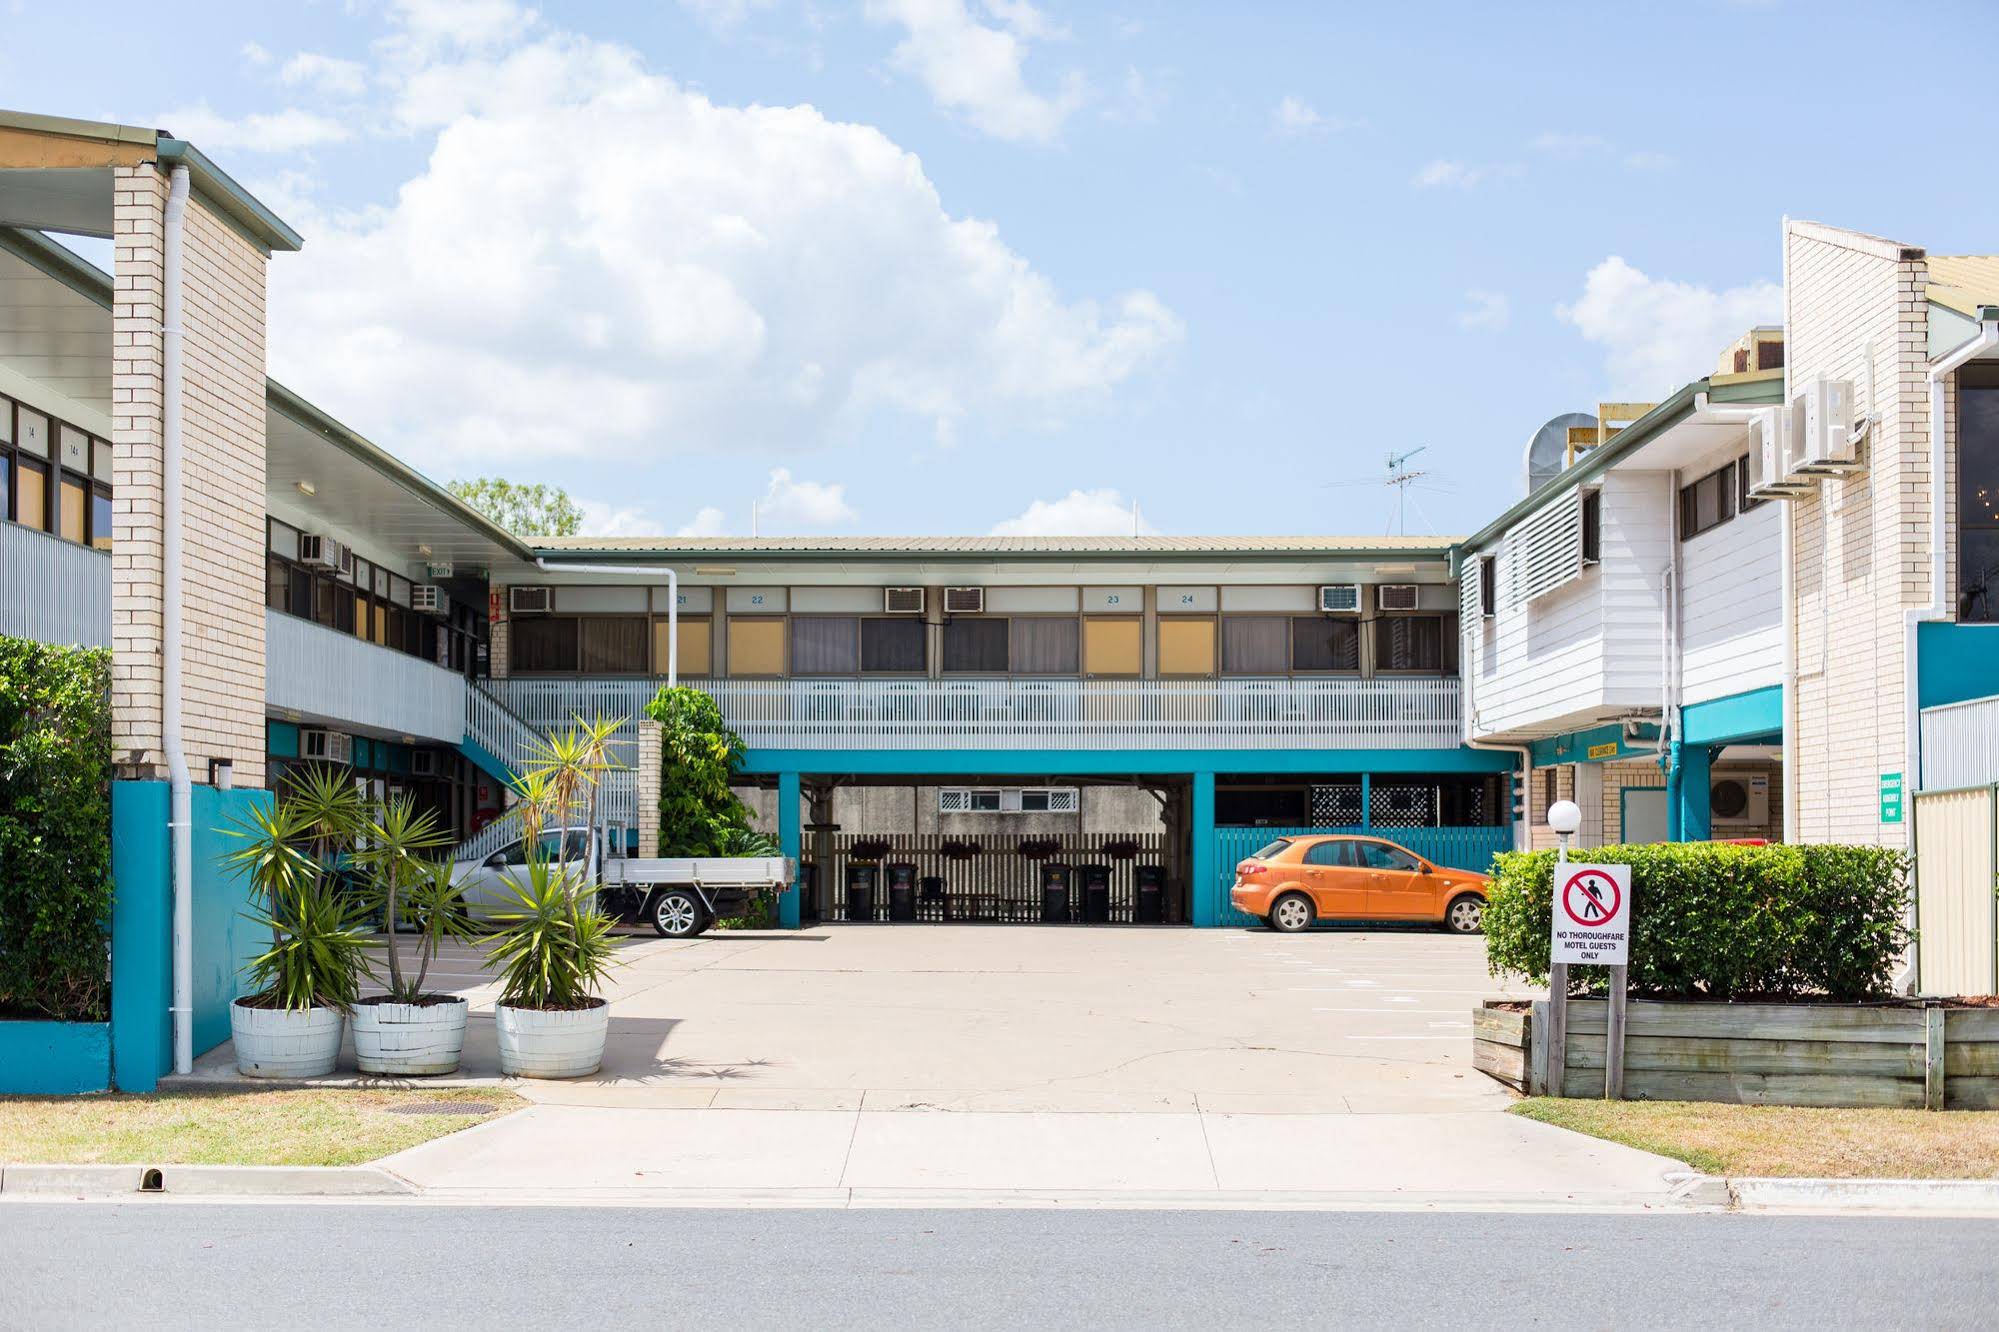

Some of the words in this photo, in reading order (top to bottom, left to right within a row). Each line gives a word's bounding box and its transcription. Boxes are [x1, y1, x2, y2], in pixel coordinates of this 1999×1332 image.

[432, 567, 447, 576] EXIT
[751, 595, 764, 605] 22
[1107, 595, 1119, 604] 23
[1181, 595, 1193, 604] 24
[1557, 931, 1568, 939] NO
[1569, 932, 1625, 941] THOROUGHFARE
[1564, 941, 1588, 949] MOTEL
[1589, 942, 1617, 950] GUESTS
[1581, 951, 1599, 959] ONLY
